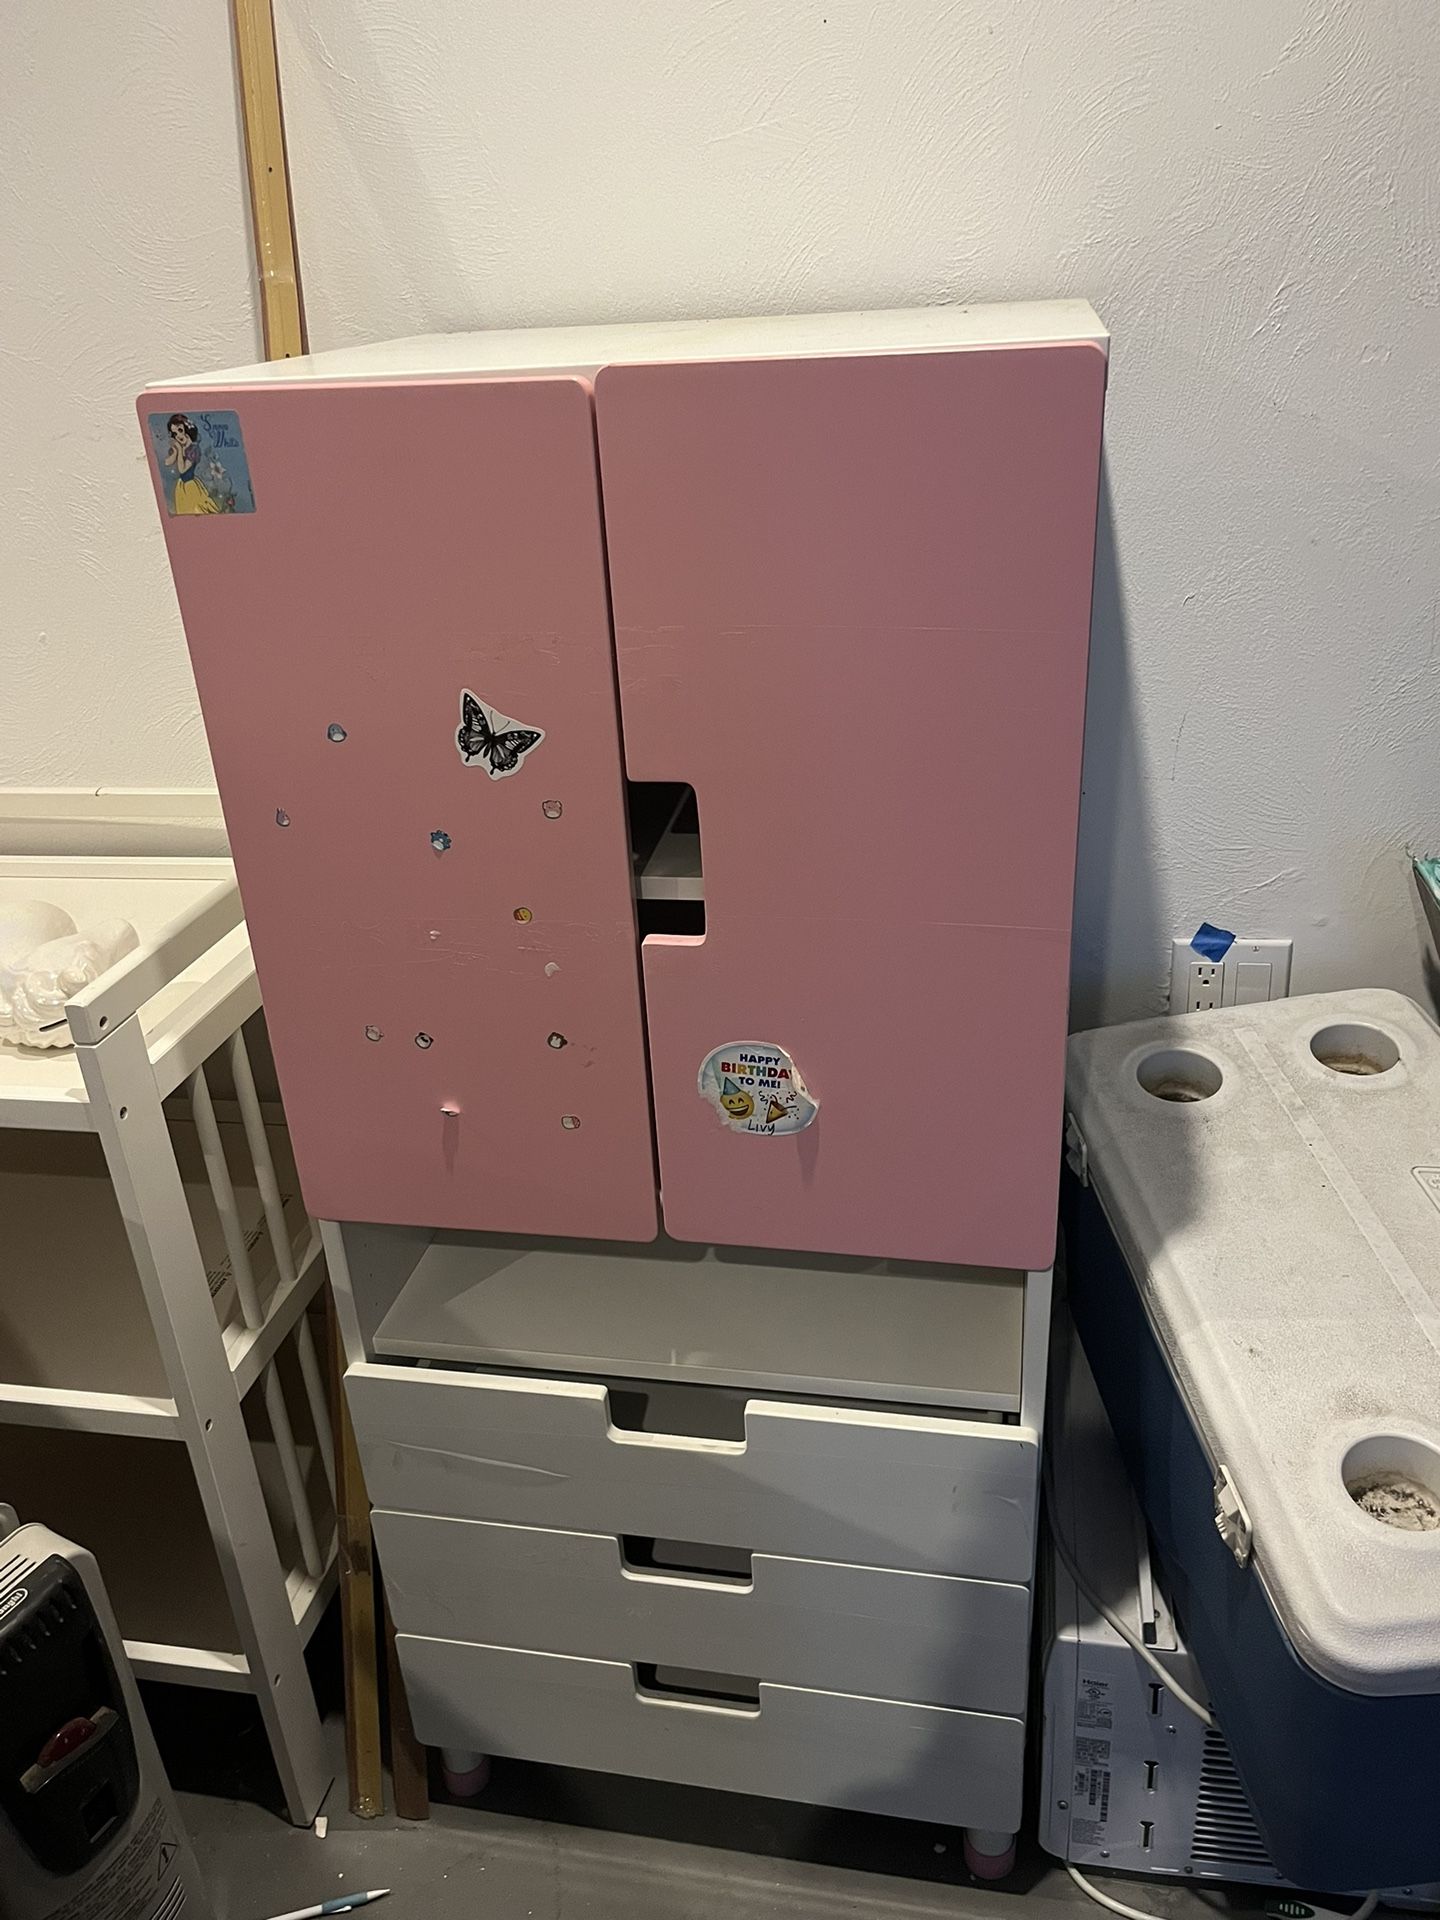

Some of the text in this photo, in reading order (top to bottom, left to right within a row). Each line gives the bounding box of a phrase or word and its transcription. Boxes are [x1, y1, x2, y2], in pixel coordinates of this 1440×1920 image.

[739, 1053, 781, 1066] HAPPY
[721, 1062, 792, 1080] BIRTHDA
[738, 1076, 781, 1089] TO ME!
